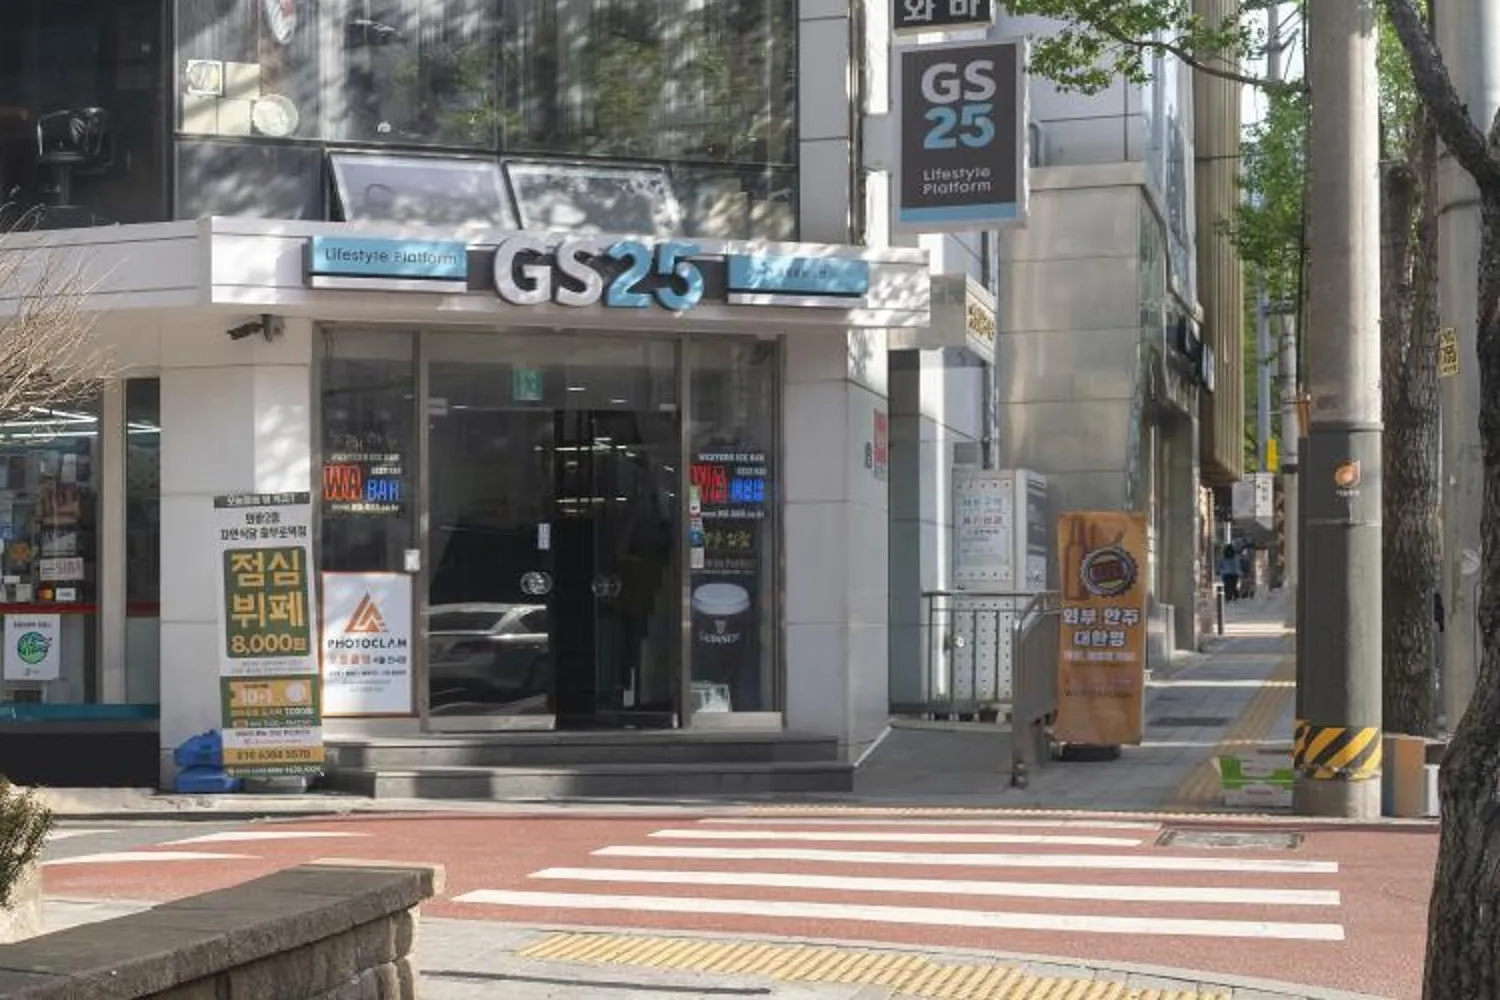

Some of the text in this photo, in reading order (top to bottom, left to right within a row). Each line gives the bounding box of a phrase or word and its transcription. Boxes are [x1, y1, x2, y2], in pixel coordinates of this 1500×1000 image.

[921, 59, 997, 104] GS
[923, 103, 996, 149] 25
[923, 167, 992, 183] Lifestyle
[923, 180, 992, 195] Platform
[325, 247, 457, 266] Lifestyle Platform
[493, 230, 704, 311] GS25
[323, 464, 364, 501] WA
[231, 550, 300, 588] 점심
[231, 591, 303, 628] 뷔페
